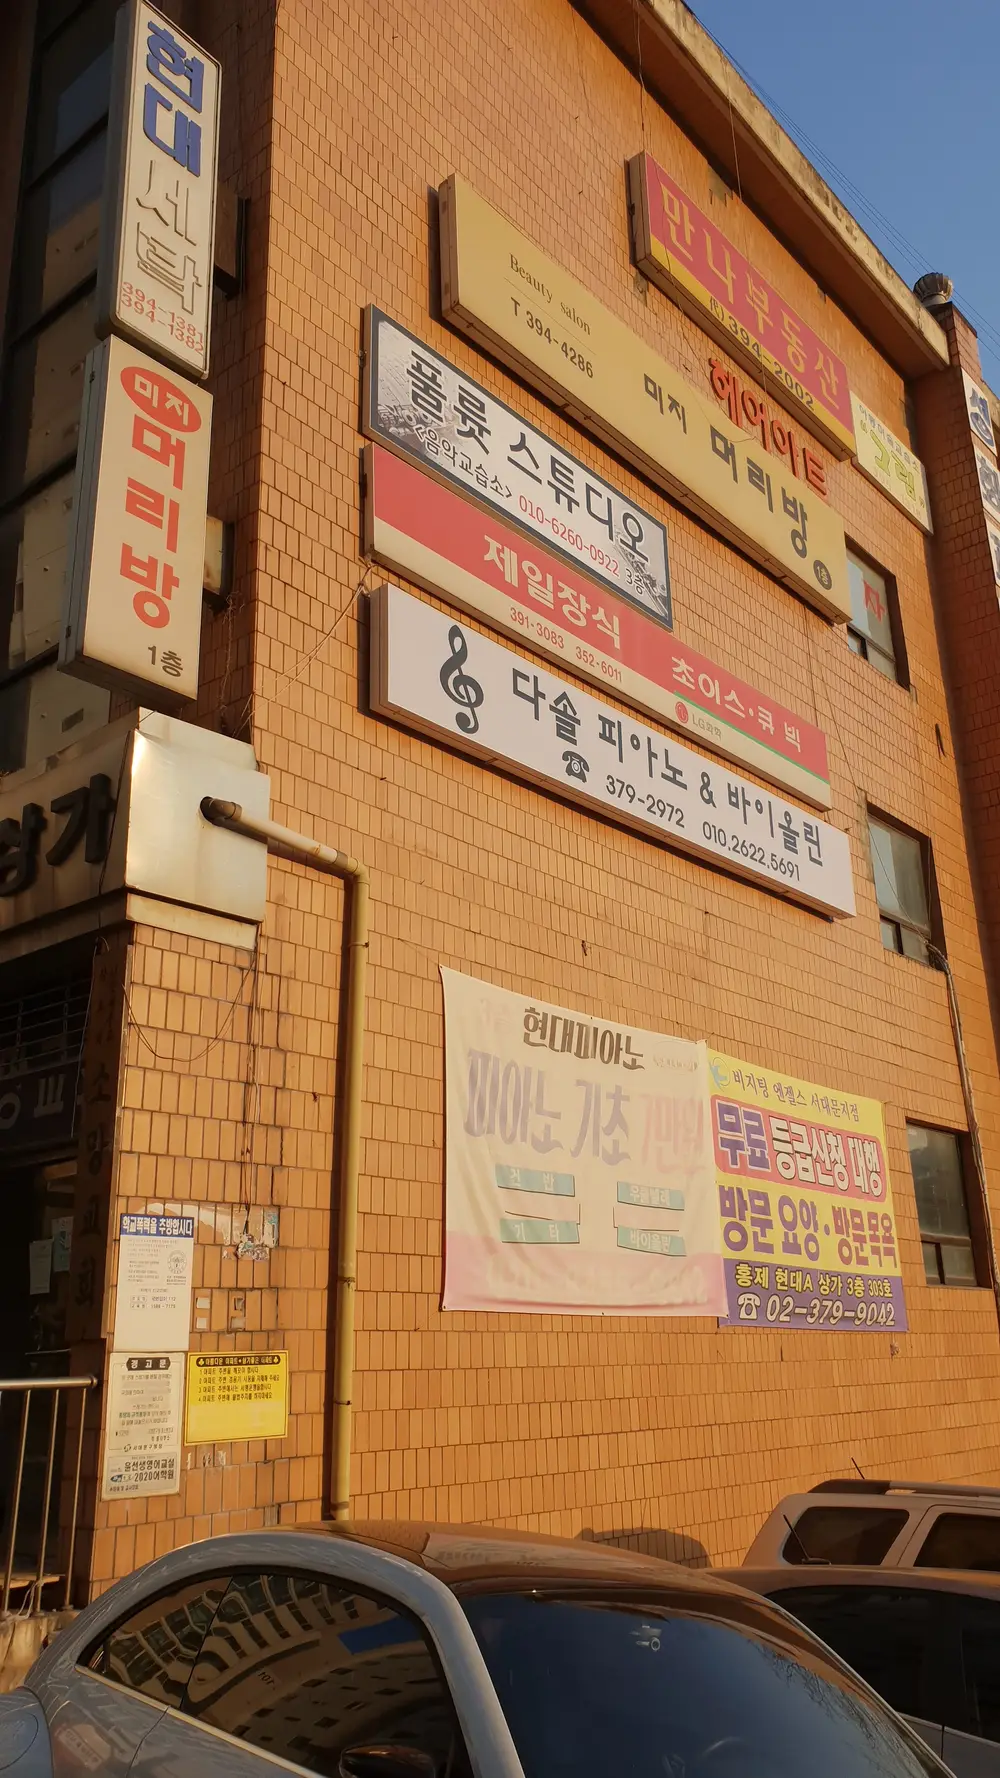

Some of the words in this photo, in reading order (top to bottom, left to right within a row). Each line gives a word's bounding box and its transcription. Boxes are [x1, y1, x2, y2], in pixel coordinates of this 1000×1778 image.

[143, 20, 204, 177] 현대
[120, 281, 204, 340] 394-1381
[120, 294, 204, 354] 394-1382
[508, 252, 553, 304] Beauty
[560, 301, 592, 336] salon
[510, 296, 521, 317] T
[525, 310, 594, 379] 394-4286
[729, 314, 815, 412] 394-2002
[133, 373, 189, 427] 미지
[708, 357, 830, 498] 헤어아트
[506, 431, 649, 562] 스튜디오
[643, 373, 687, 435] 미지
[709, 425, 808, 559] 머리방
[119, 413, 187, 629] 머리방
[413, 424, 514, 499] <음악교습소>
[518, 495, 620, 577] 010-6260-0922
[624, 567, 645, 595] 3층
[483, 534, 621, 649] 제일장식
[147, 645, 184, 678] 1층
[509, 607, 565, 649] 391-3083
[575, 645, 623, 684] 352-6011
[511, 667, 582, 746] 다솔
[598, 712, 688, 790] 피아노
[699, 770, 717, 809] &
[727, 780, 824, 868] 바이올린
[605, 774, 685, 829] 379-2972
[702, 820, 801, 882] 010.2622.5691
[522, 1005, 646, 1071] 현대피아노
[462, 1046, 564, 1155] 피아노
[569, 1078, 632, 1167] 기초
[715, 1099, 772, 1172] 무료
[732, 1068, 769, 1099] 비지팅
[772, 1081, 807, 1107] 엔젤스
[811, 1092, 860, 1122] 서대문지점
[158, 1218, 193, 1236] 추방합시다
[735, 1261, 769, 1290] 홍제
[774, 1266, 814, 1293] 현대A
[818, 1273, 843, 1296] 상가
[846, 1277, 865, 1298] 3층
[867, 1278, 893, 1298] 303호
[765, 1293, 896, 1327] 02-379-9042
